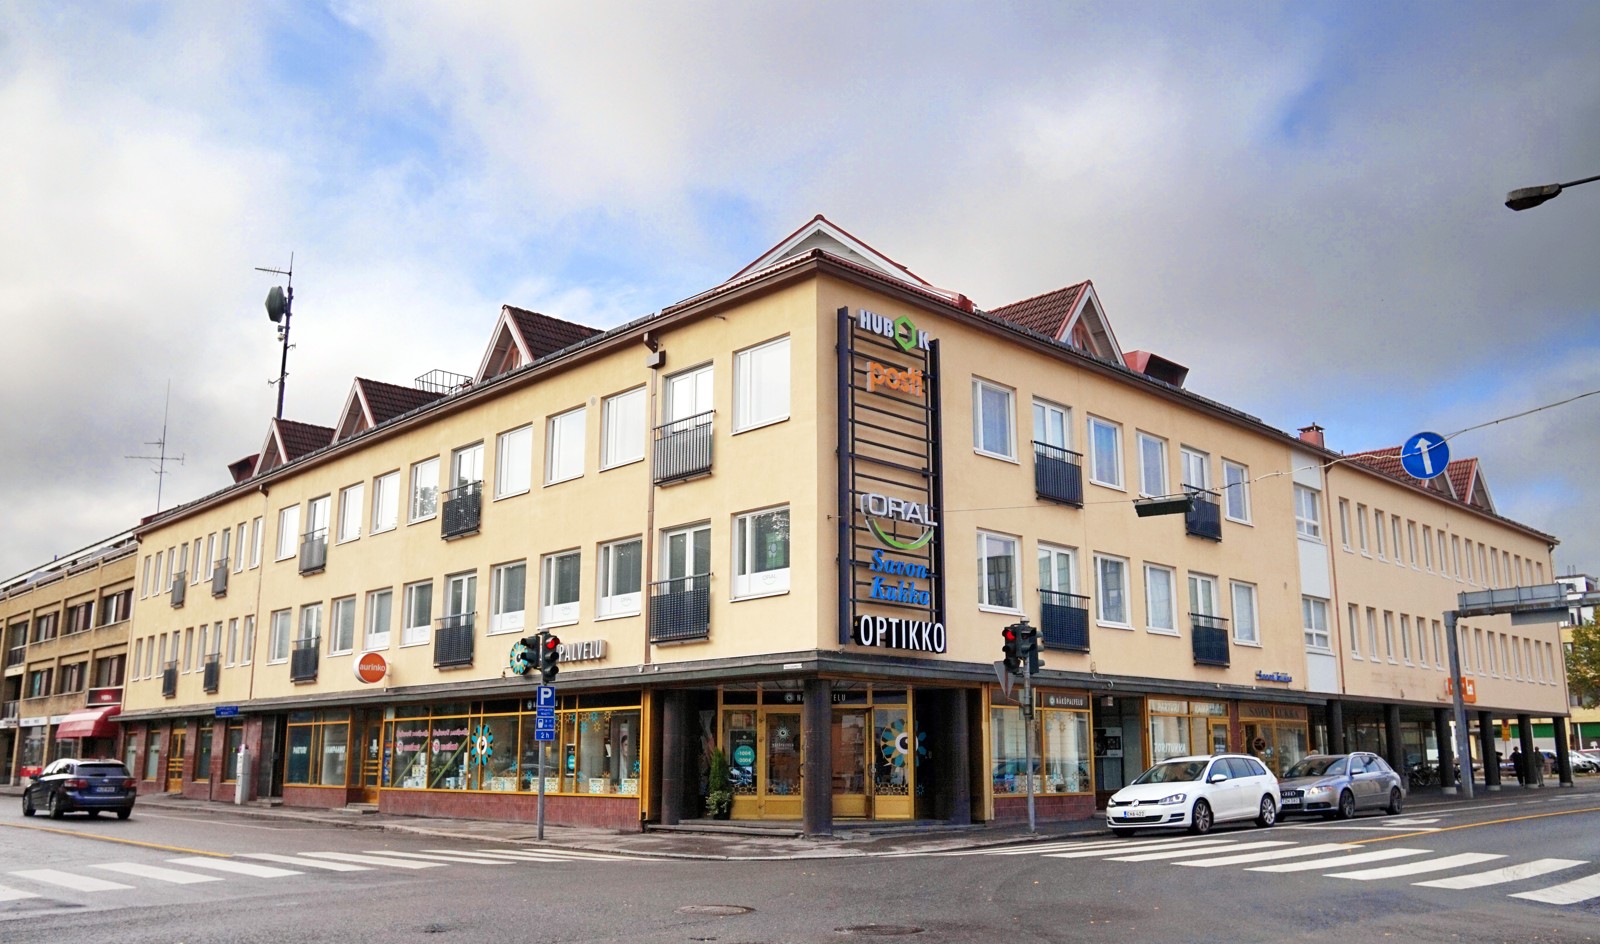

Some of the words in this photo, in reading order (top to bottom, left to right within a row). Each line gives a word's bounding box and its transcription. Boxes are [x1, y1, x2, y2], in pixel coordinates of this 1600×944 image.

[867, 361, 924, 397] posti
[863, 493, 938, 526] ORAL
[870, 549, 928, 579] Savon
[860, 614, 945, 653] OPTIKKO
[558, 640, 602, 662] PALVELU
[359, 664, 386, 672] aurinko
[540, 687, 552, 705] P
